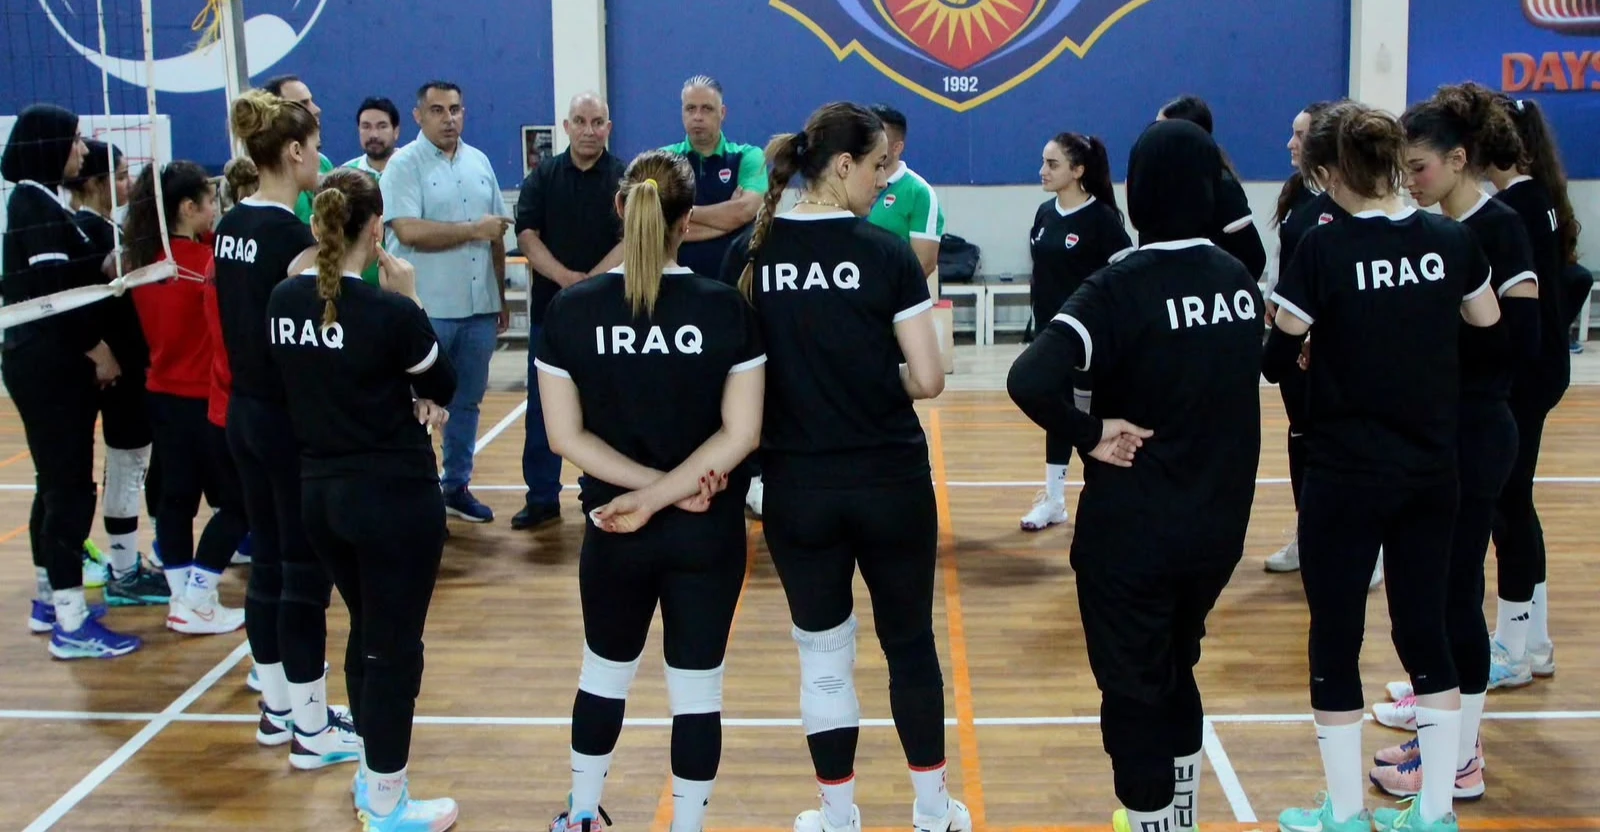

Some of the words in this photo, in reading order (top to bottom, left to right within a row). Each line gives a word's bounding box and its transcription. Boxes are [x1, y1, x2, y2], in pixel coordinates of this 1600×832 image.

[943, 76, 979, 92] 1992
[1502, 51, 1600, 92] DAY
[214, 234, 258, 264] IRAQ
[761, 261, 861, 293] IRAQ
[1355, 252, 1446, 291] IRAQ
[1166, 289, 1257, 330] IRAQ
[270, 317, 344, 350] IRAQ
[595, 324, 703, 355] IRAQ
